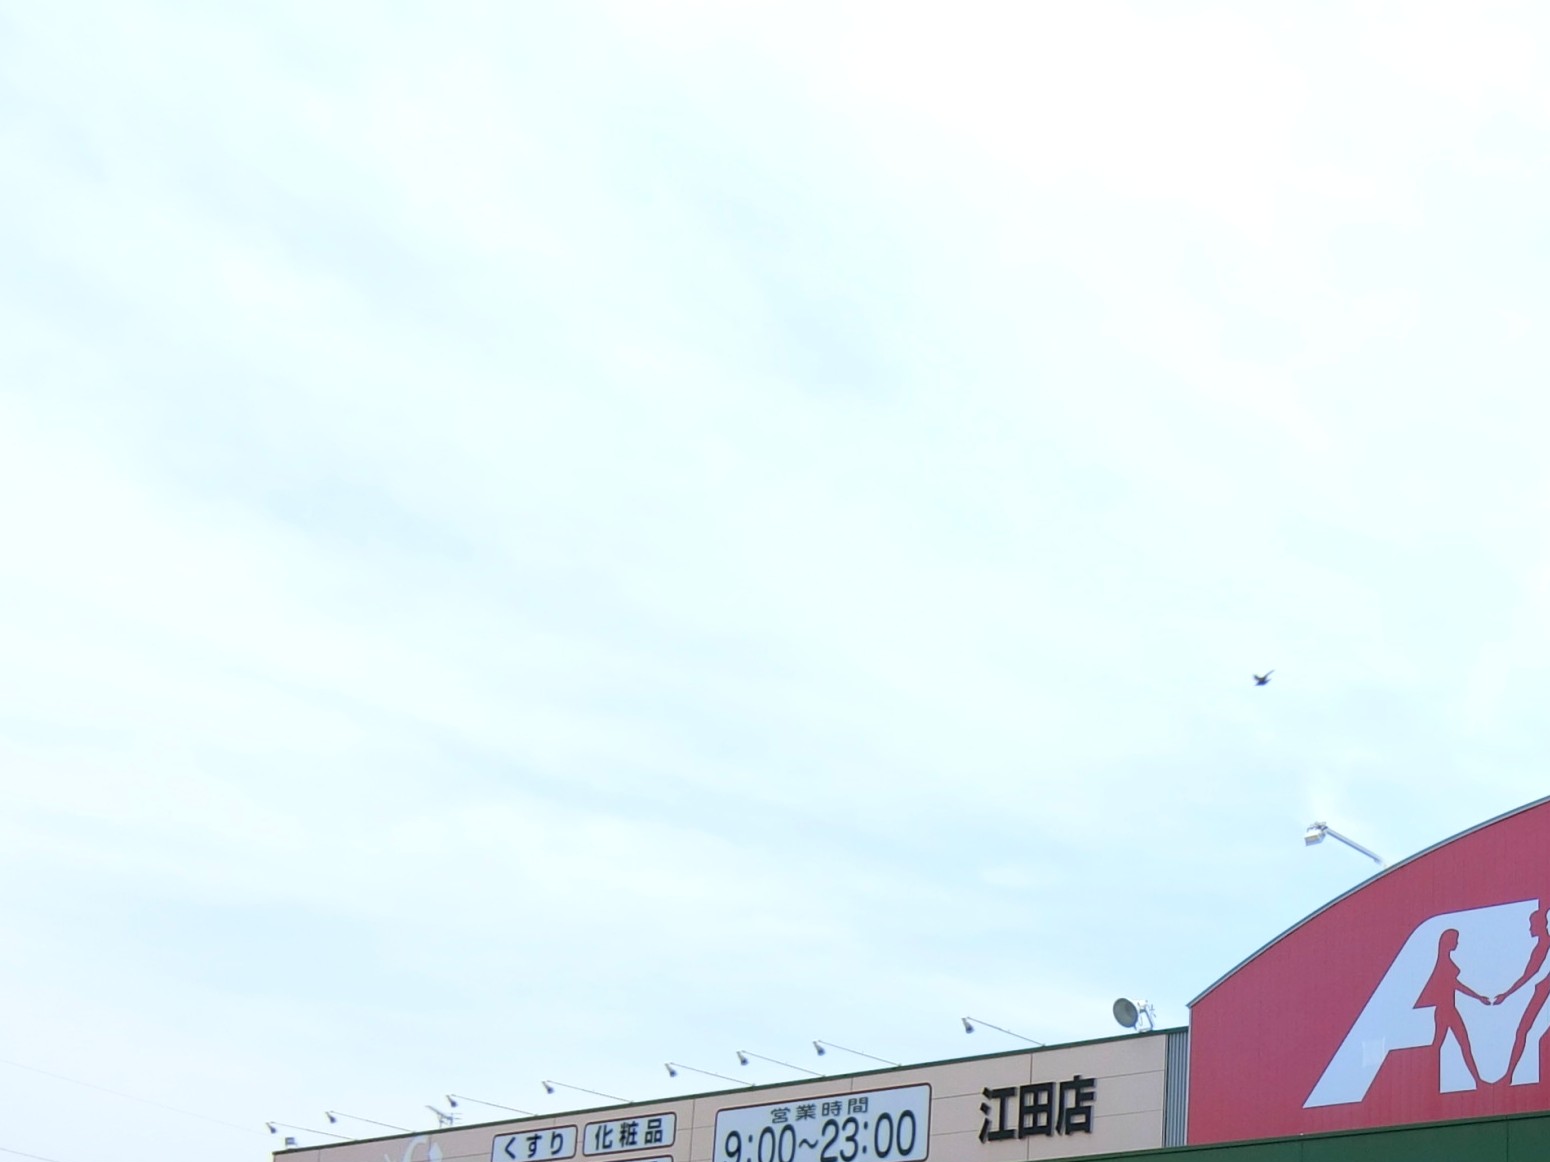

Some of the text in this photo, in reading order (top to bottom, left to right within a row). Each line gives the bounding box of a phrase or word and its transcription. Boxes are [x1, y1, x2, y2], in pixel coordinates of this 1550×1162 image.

[770, 1097, 869, 1124] 営業時間
[978, 1074, 1096, 1143] 江田店
[504, 1131, 564, 1160] くすり
[594, 1118, 663, 1150] 化粧品
